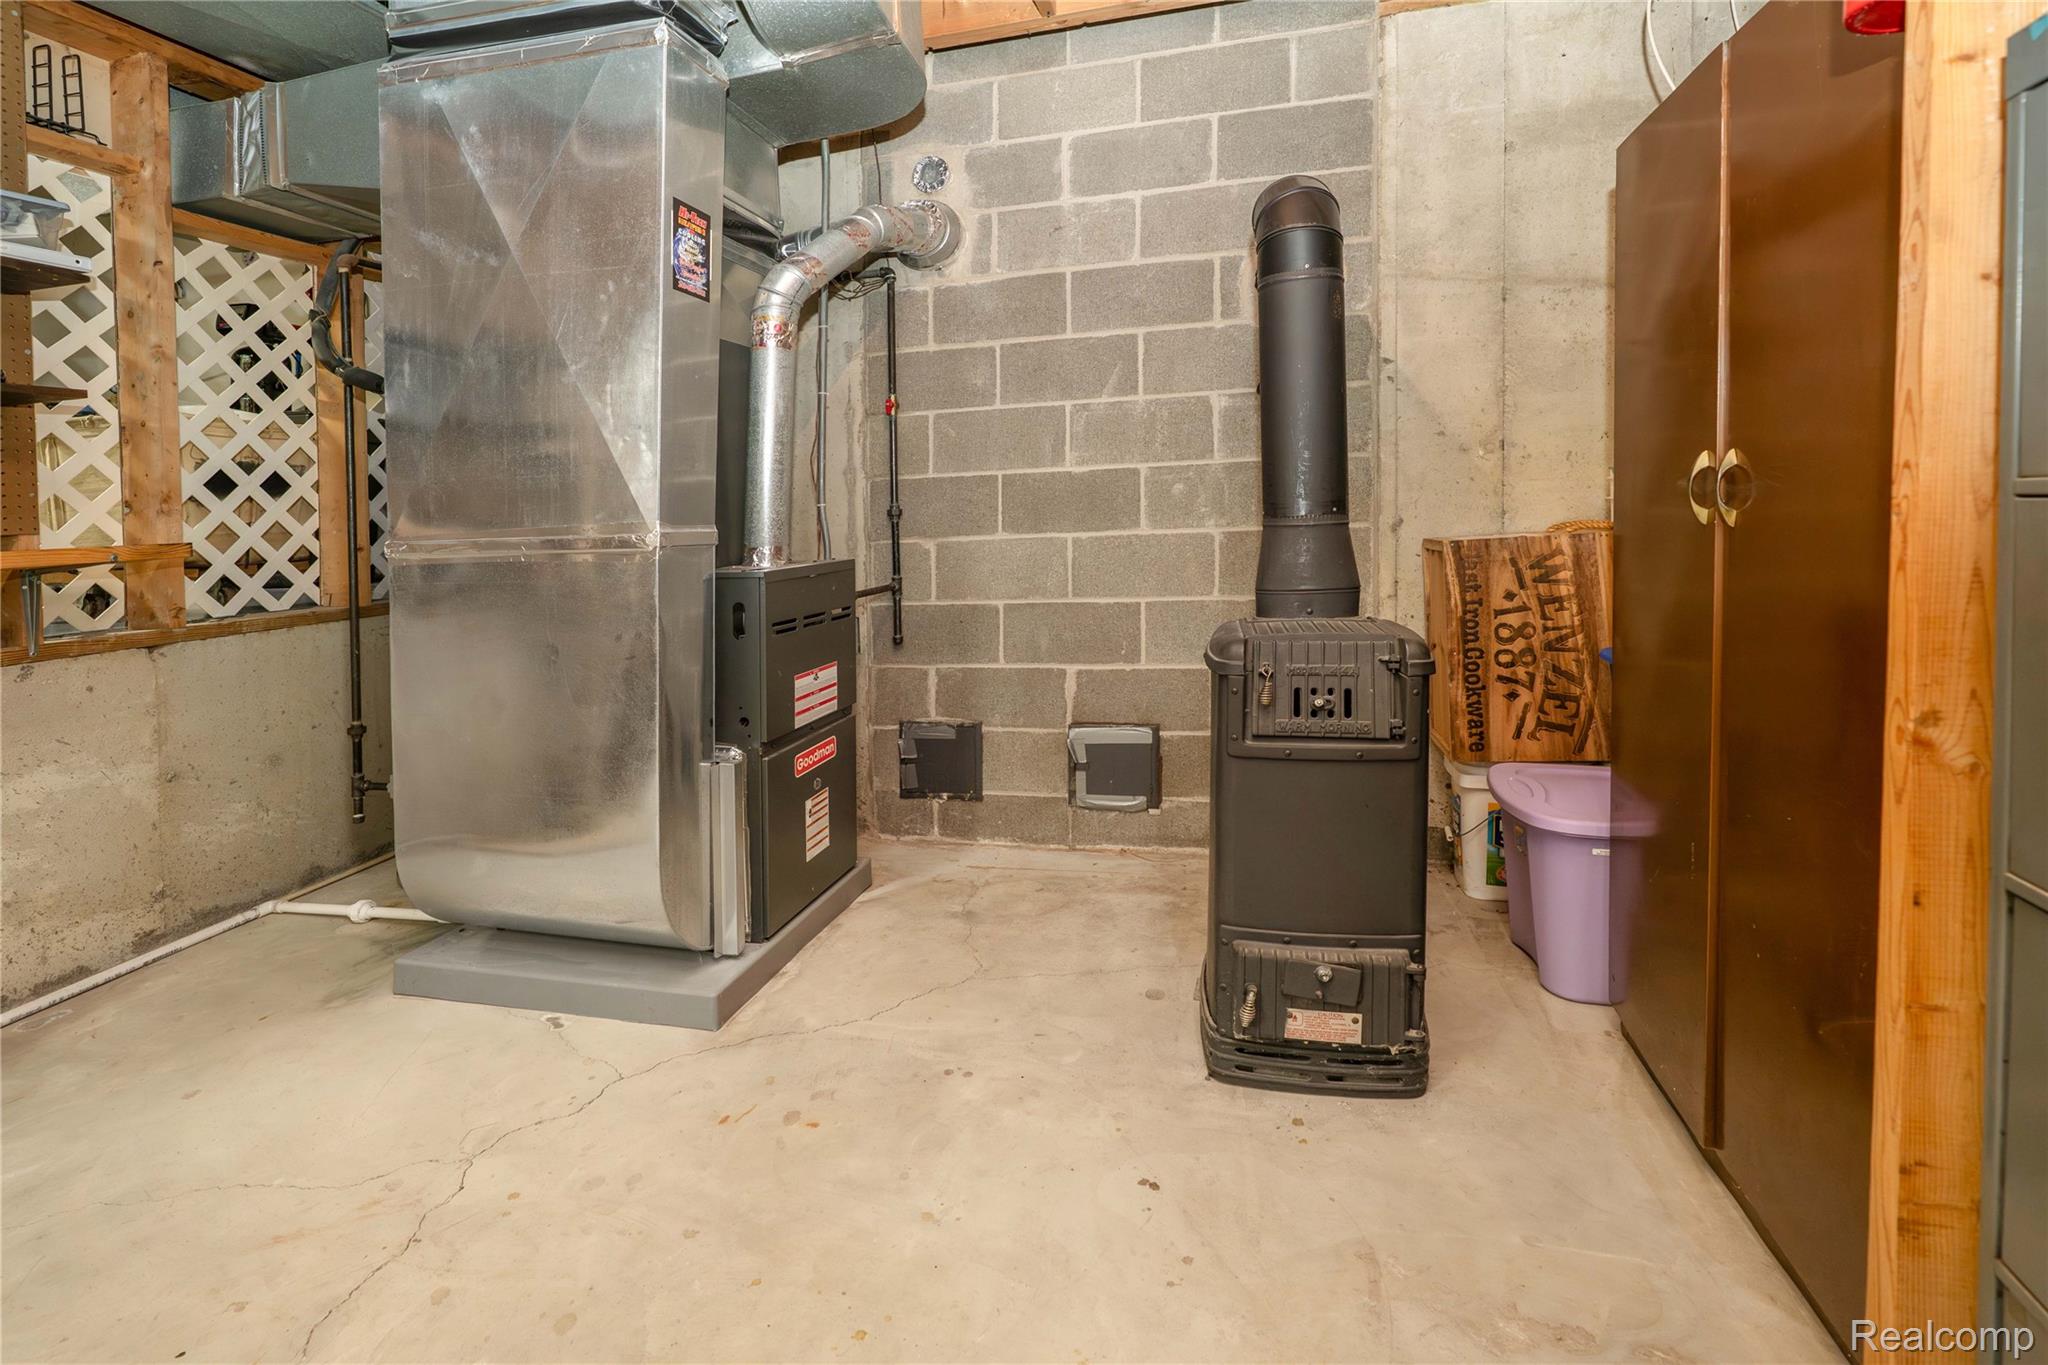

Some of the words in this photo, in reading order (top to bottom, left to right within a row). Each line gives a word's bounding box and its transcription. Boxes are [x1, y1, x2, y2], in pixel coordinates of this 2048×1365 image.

[1462, 597, 1484, 647] Iron
[1492, 605, 1538, 693] 1887
[1526, 547, 1585, 742] WENZEL
[1278, 721, 1311, 732] WARM
[1320, 722, 1371, 734] MORNING
[1463, 647, 1486, 754] Cookware
[797, 743, 834, 771] Goodman
